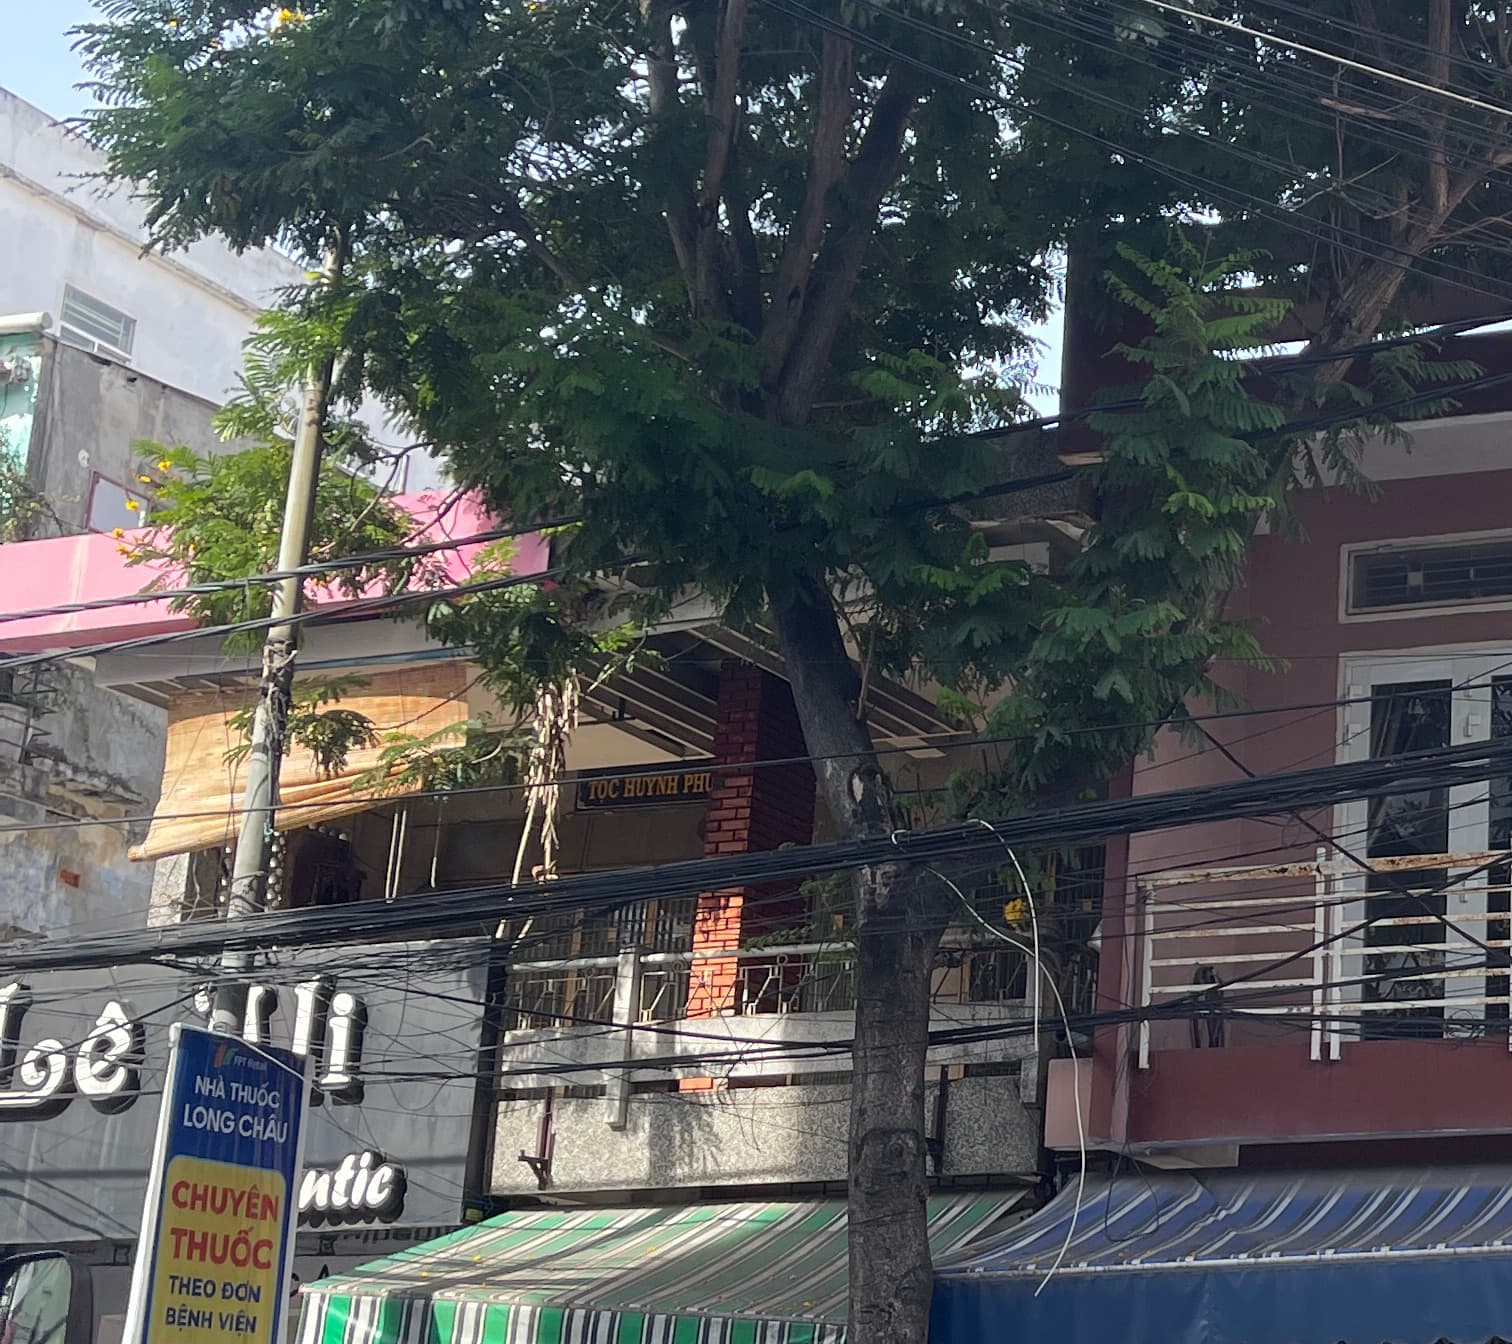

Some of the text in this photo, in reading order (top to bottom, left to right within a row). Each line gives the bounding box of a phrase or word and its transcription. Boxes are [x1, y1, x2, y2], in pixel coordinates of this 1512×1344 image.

[195, 1074, 281, 1109] NHÀ THUỐC
[183, 1103, 288, 1144] LONG CHÂU
[171, 1180, 279, 1223] CHUYÊN
[170, 1226, 274, 1271] THUỐC
[168, 1274, 217, 1299] THEO
[221, 1280, 262, 1304] ĐƠN
[165, 1302, 257, 1337] BỆNH VIỆN
